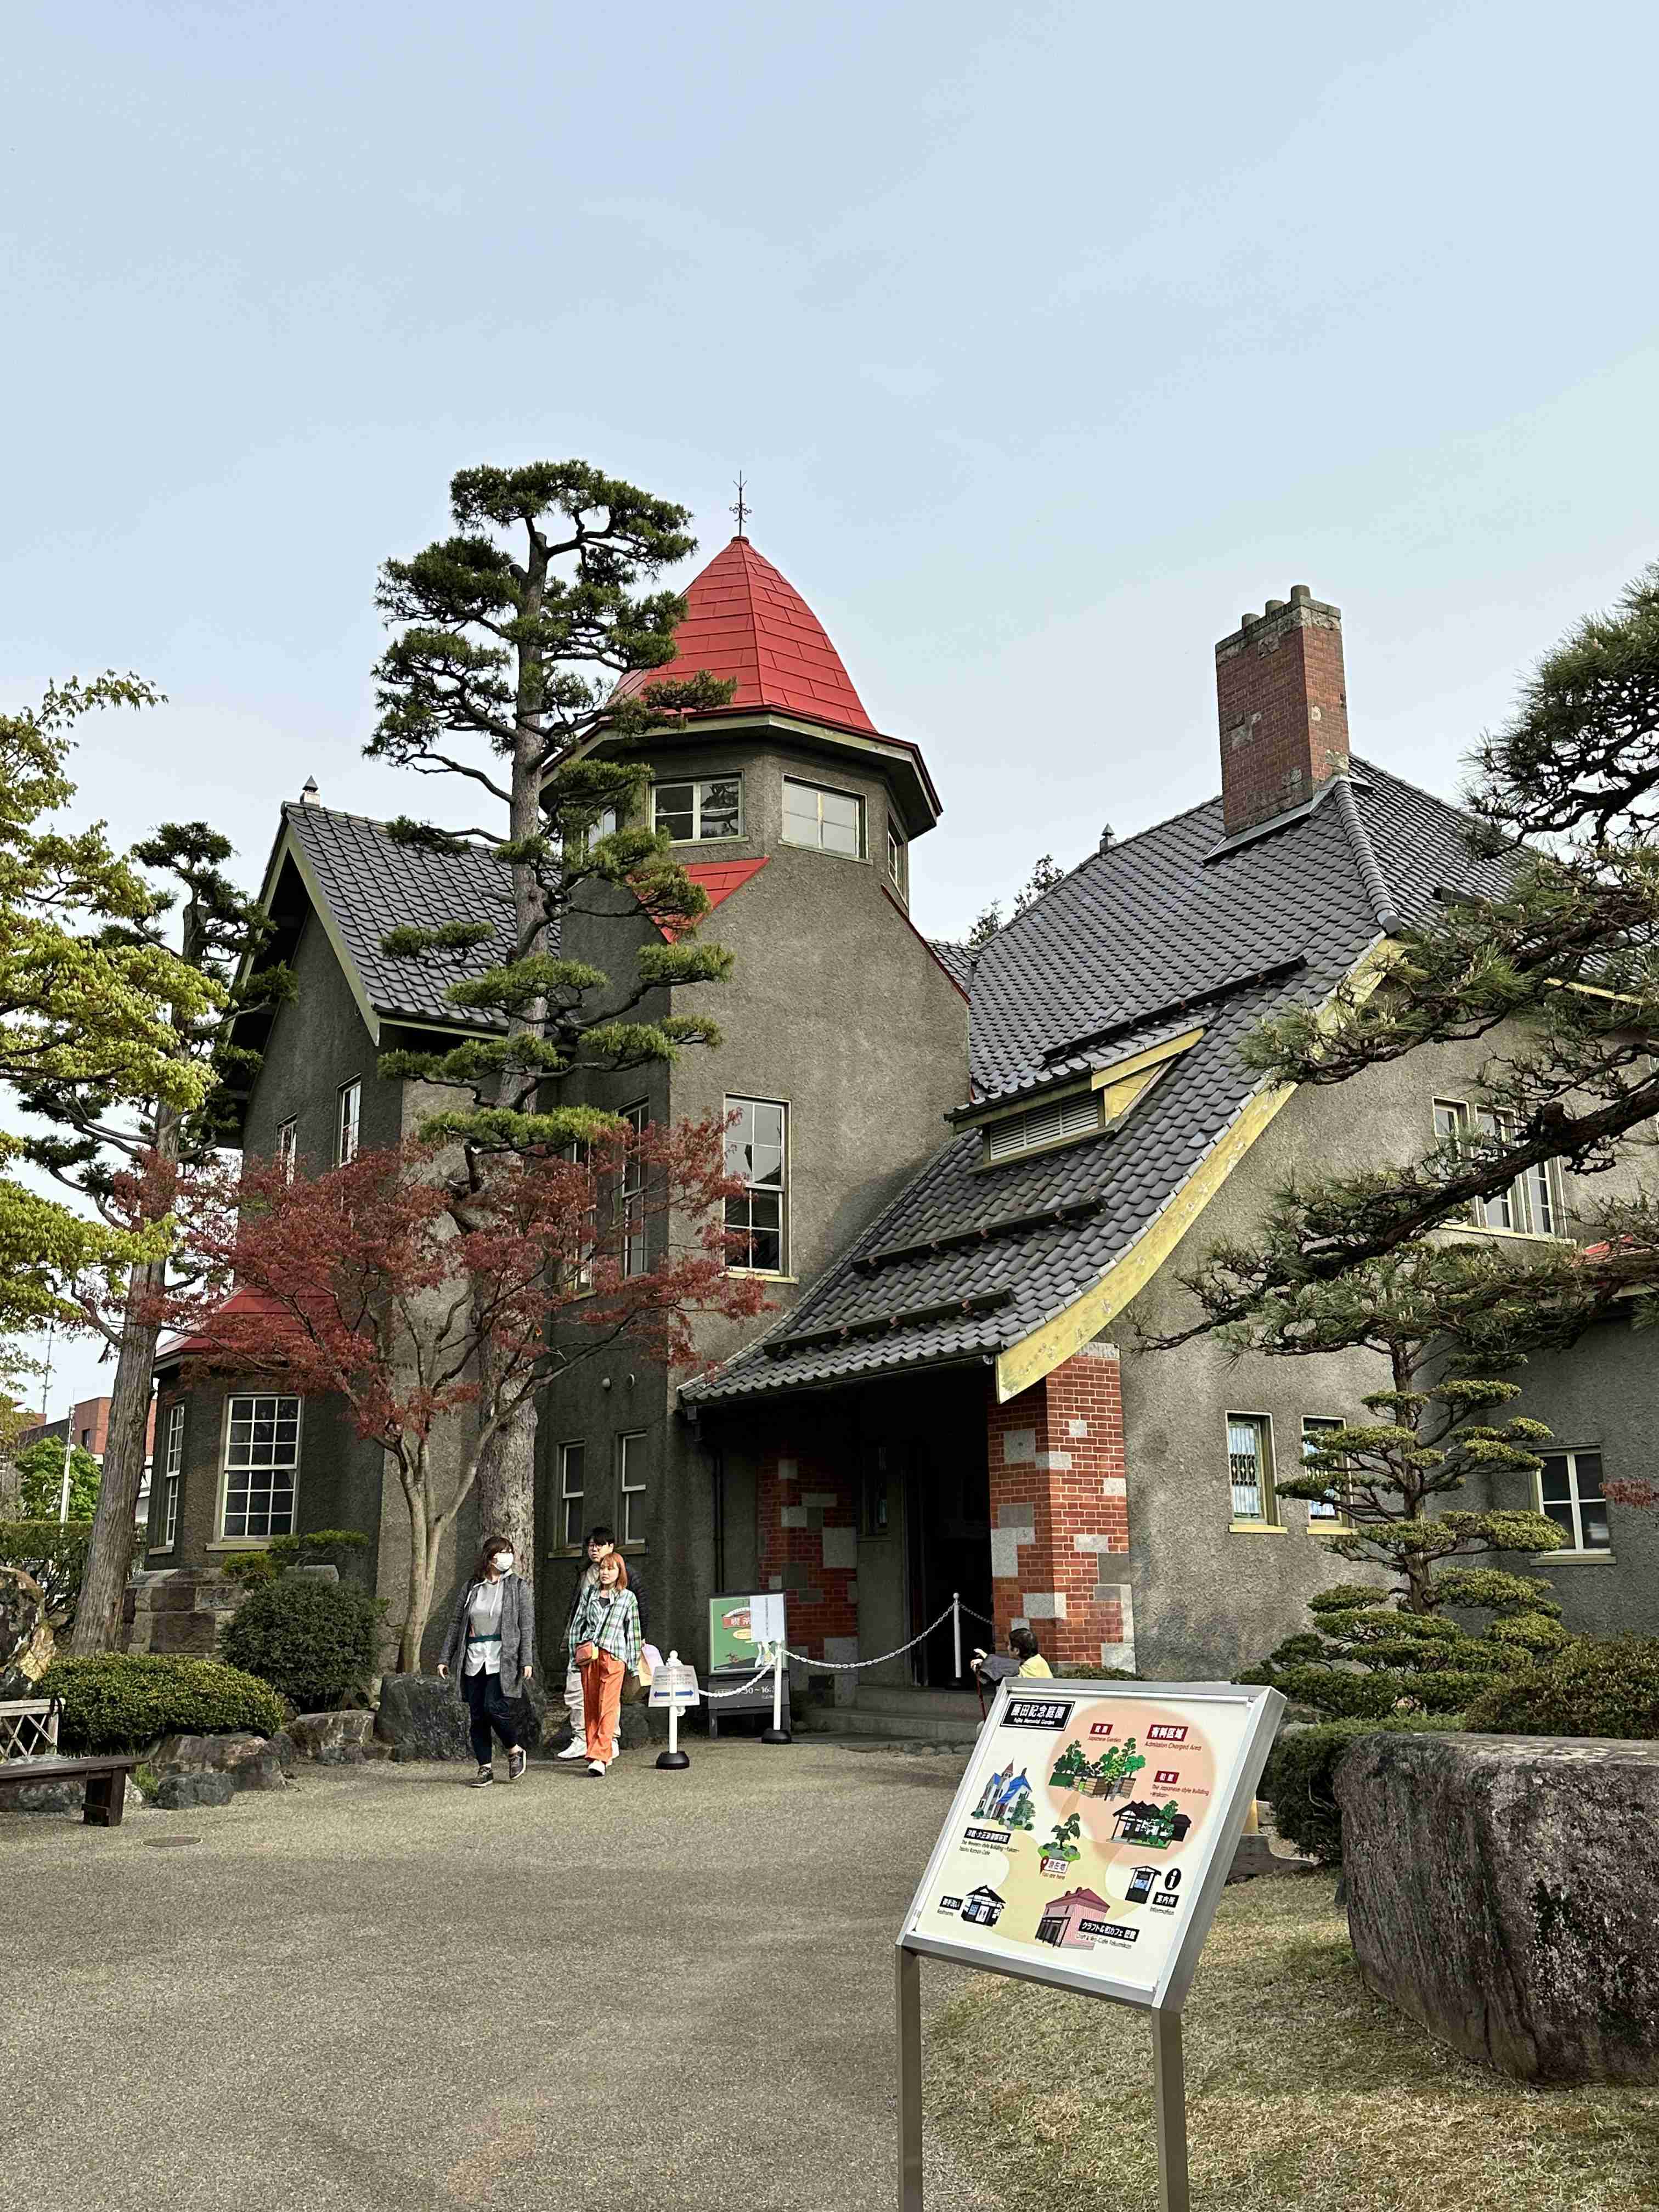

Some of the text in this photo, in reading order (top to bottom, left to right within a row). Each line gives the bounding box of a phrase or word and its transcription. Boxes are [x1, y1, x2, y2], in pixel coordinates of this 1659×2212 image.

[1011, 1704, 1066, 1719] 藤田記念庭園
[1152, 1726, 1185, 1739] 有料区域
[1168, 1742, 1189, 1751] Charged
[1192, 1787, 1210, 1796] Building
[1150, 1906, 1175, 1916] Information
